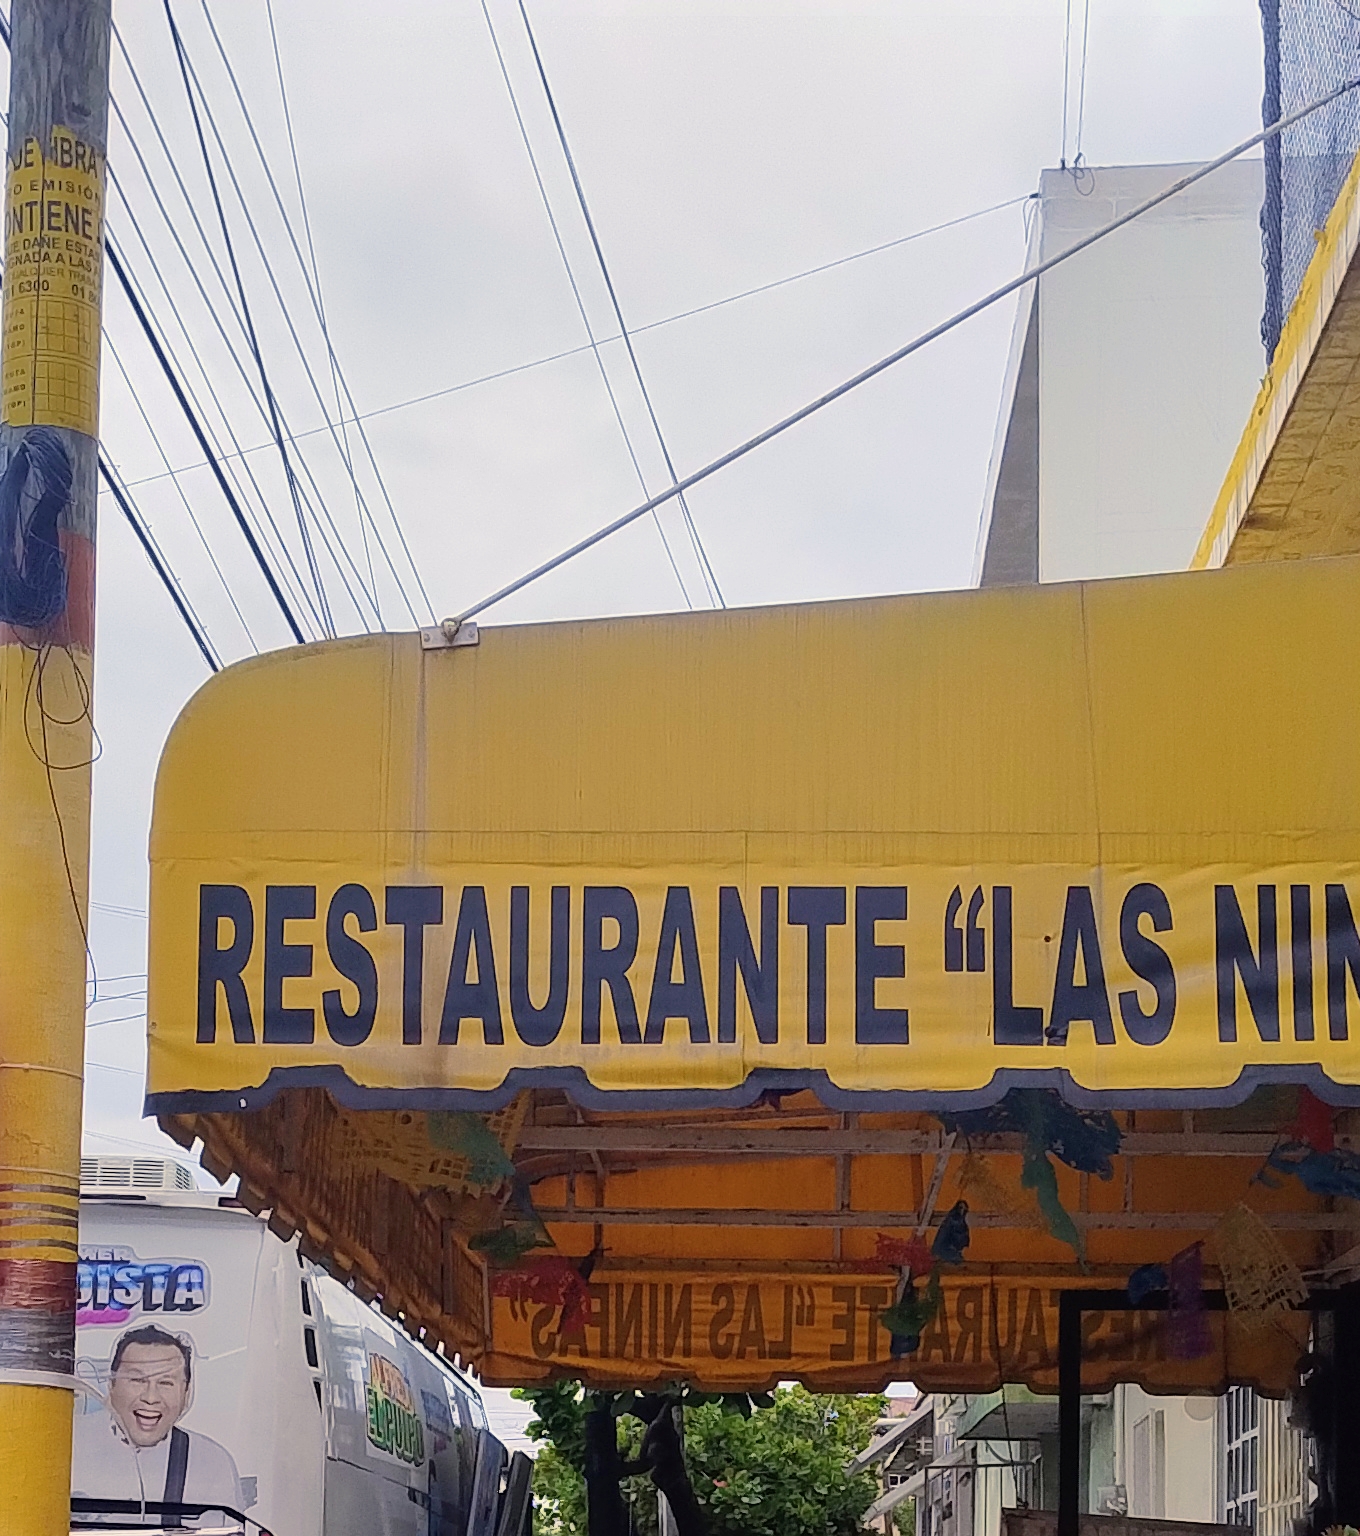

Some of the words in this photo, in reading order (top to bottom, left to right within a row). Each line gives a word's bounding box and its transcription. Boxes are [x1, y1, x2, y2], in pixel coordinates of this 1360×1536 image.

[5, 200, 93, 246] ONTIENE
[55, 252, 66, 264] A
[195, 882, 910, 1047] RESTAURANTE
